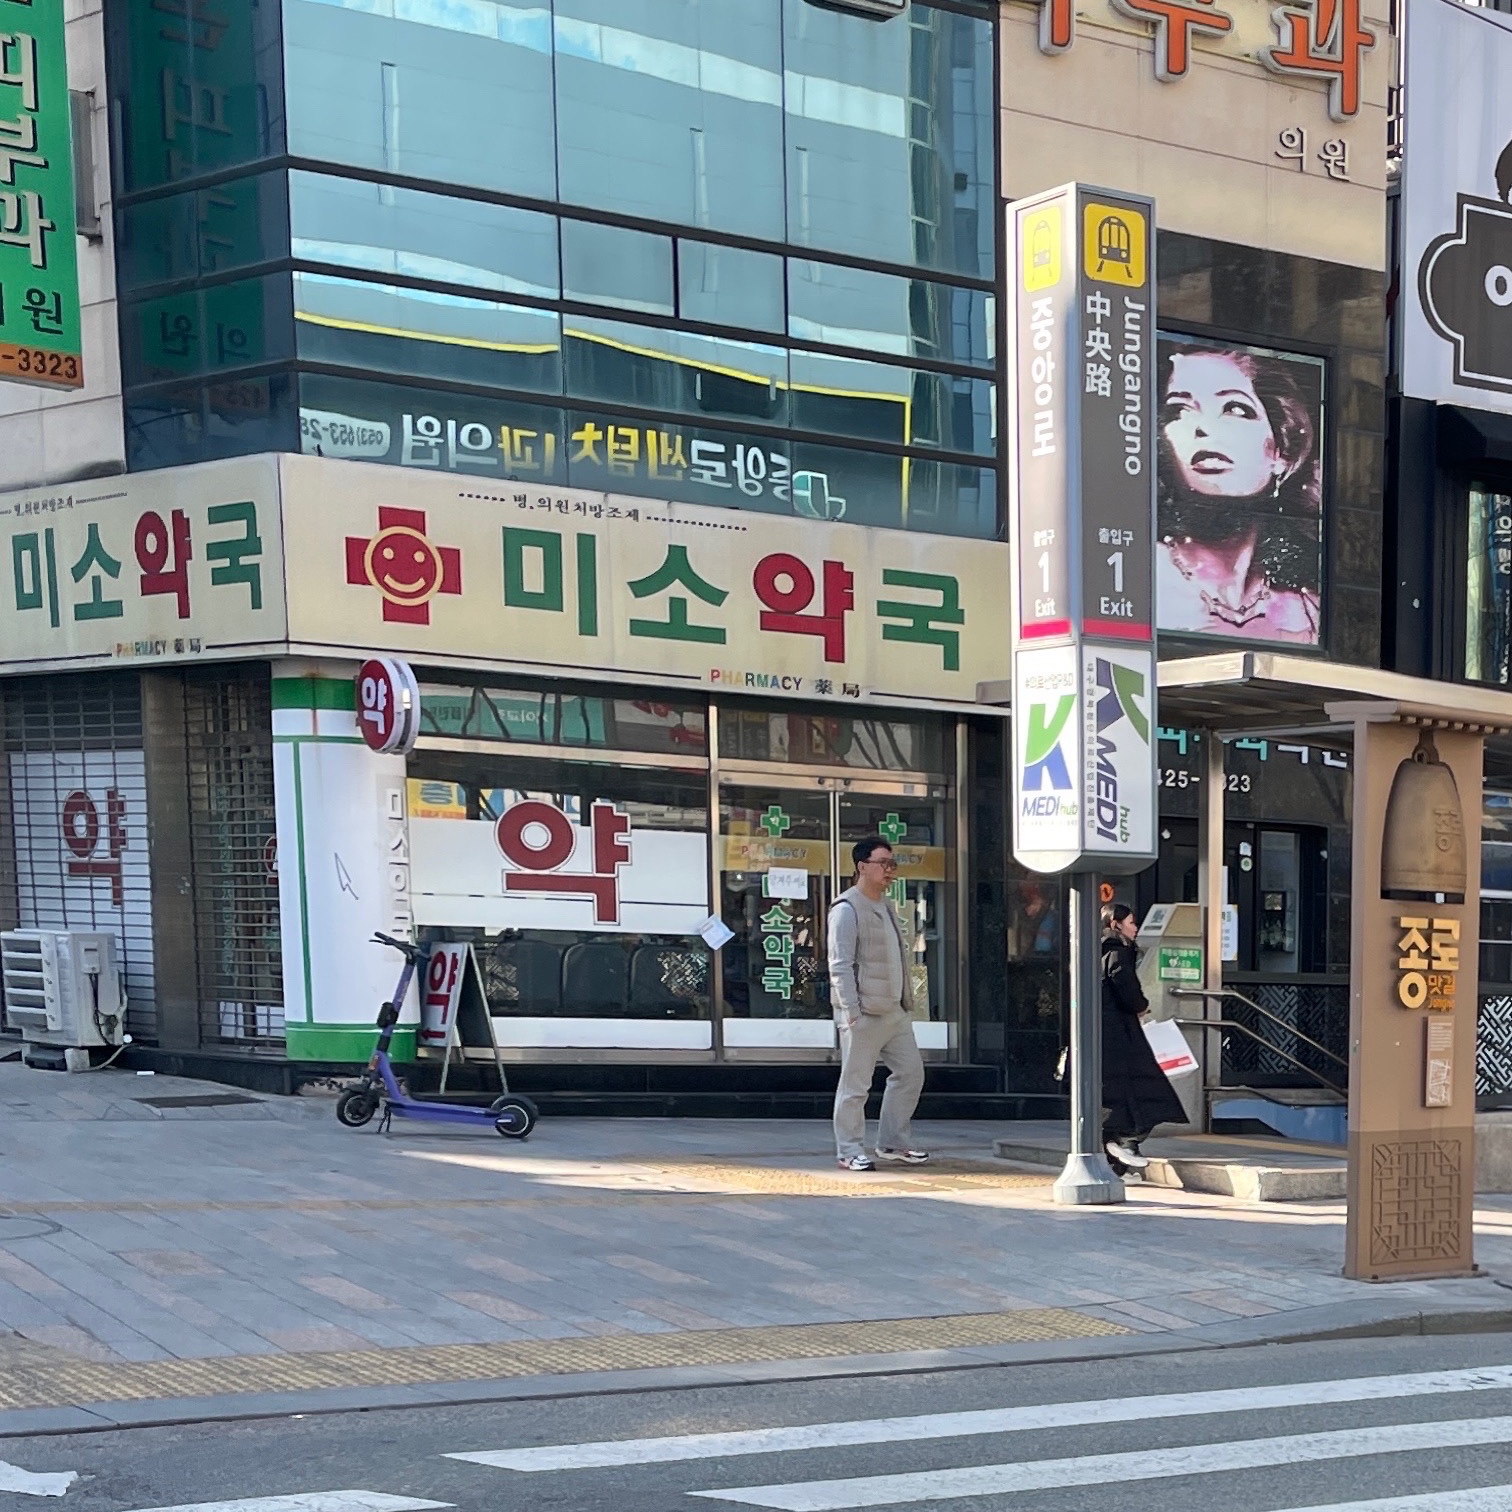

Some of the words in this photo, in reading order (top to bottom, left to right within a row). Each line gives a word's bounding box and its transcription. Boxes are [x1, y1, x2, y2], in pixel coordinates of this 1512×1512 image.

[1276, 128, 1351, 181] 의원
[1085, 290, 1112, 397] 中央路
[1030, 296, 1056, 458] 중앙로
[1119, 296, 1146, 476] Jungangno
[12, 501, 262, 628] 미소약국
[1098, 528, 1135, 547] 출입구
[502, 526, 965, 671] 미소약국
[1038, 550, 1050, 593] 1
[1107, 551, 1123, 593] 1
[1035, 598, 1056, 618] Exit
[1100, 597, 1134, 618] Exit
[116, 640, 167, 657] PHARMACY
[361, 675, 388, 735] 약
[709, 668, 803, 692] PHARMACY
[1022, 795, 1061, 818] MEDI
[1096, 735, 1118, 843] MEDI
[1119, 805, 1131, 844] hub
[61, 786, 128, 909] 약
[493, 797, 633, 926] 약
[425, 950, 459, 1025] 약
